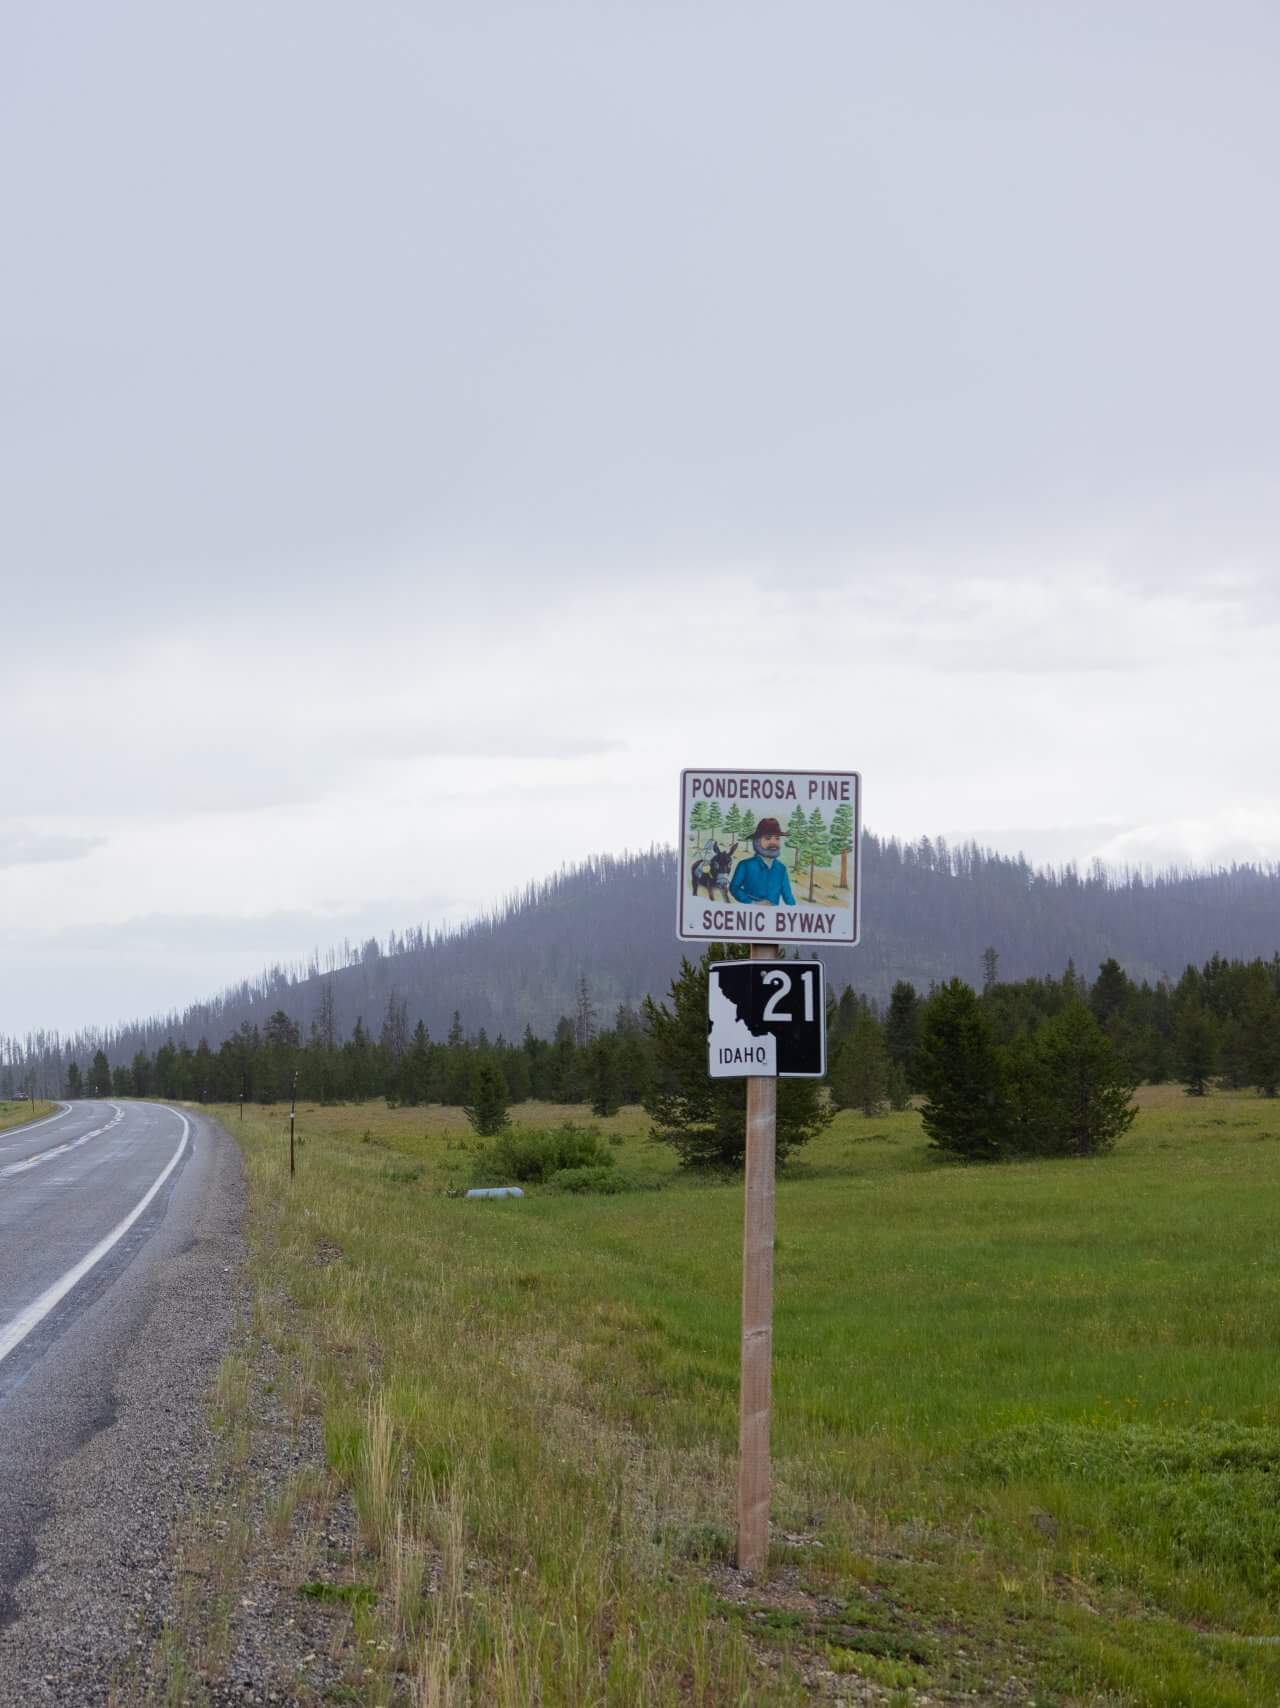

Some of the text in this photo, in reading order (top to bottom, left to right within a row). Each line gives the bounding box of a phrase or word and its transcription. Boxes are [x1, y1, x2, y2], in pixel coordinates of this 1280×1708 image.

[692, 778, 850, 801] PONDEROSA PINE
[702, 910, 836, 934] SCENIC BYWAY
[761, 969, 814, 1022] 21
[719, 1046, 766, 1065] IDAHO
